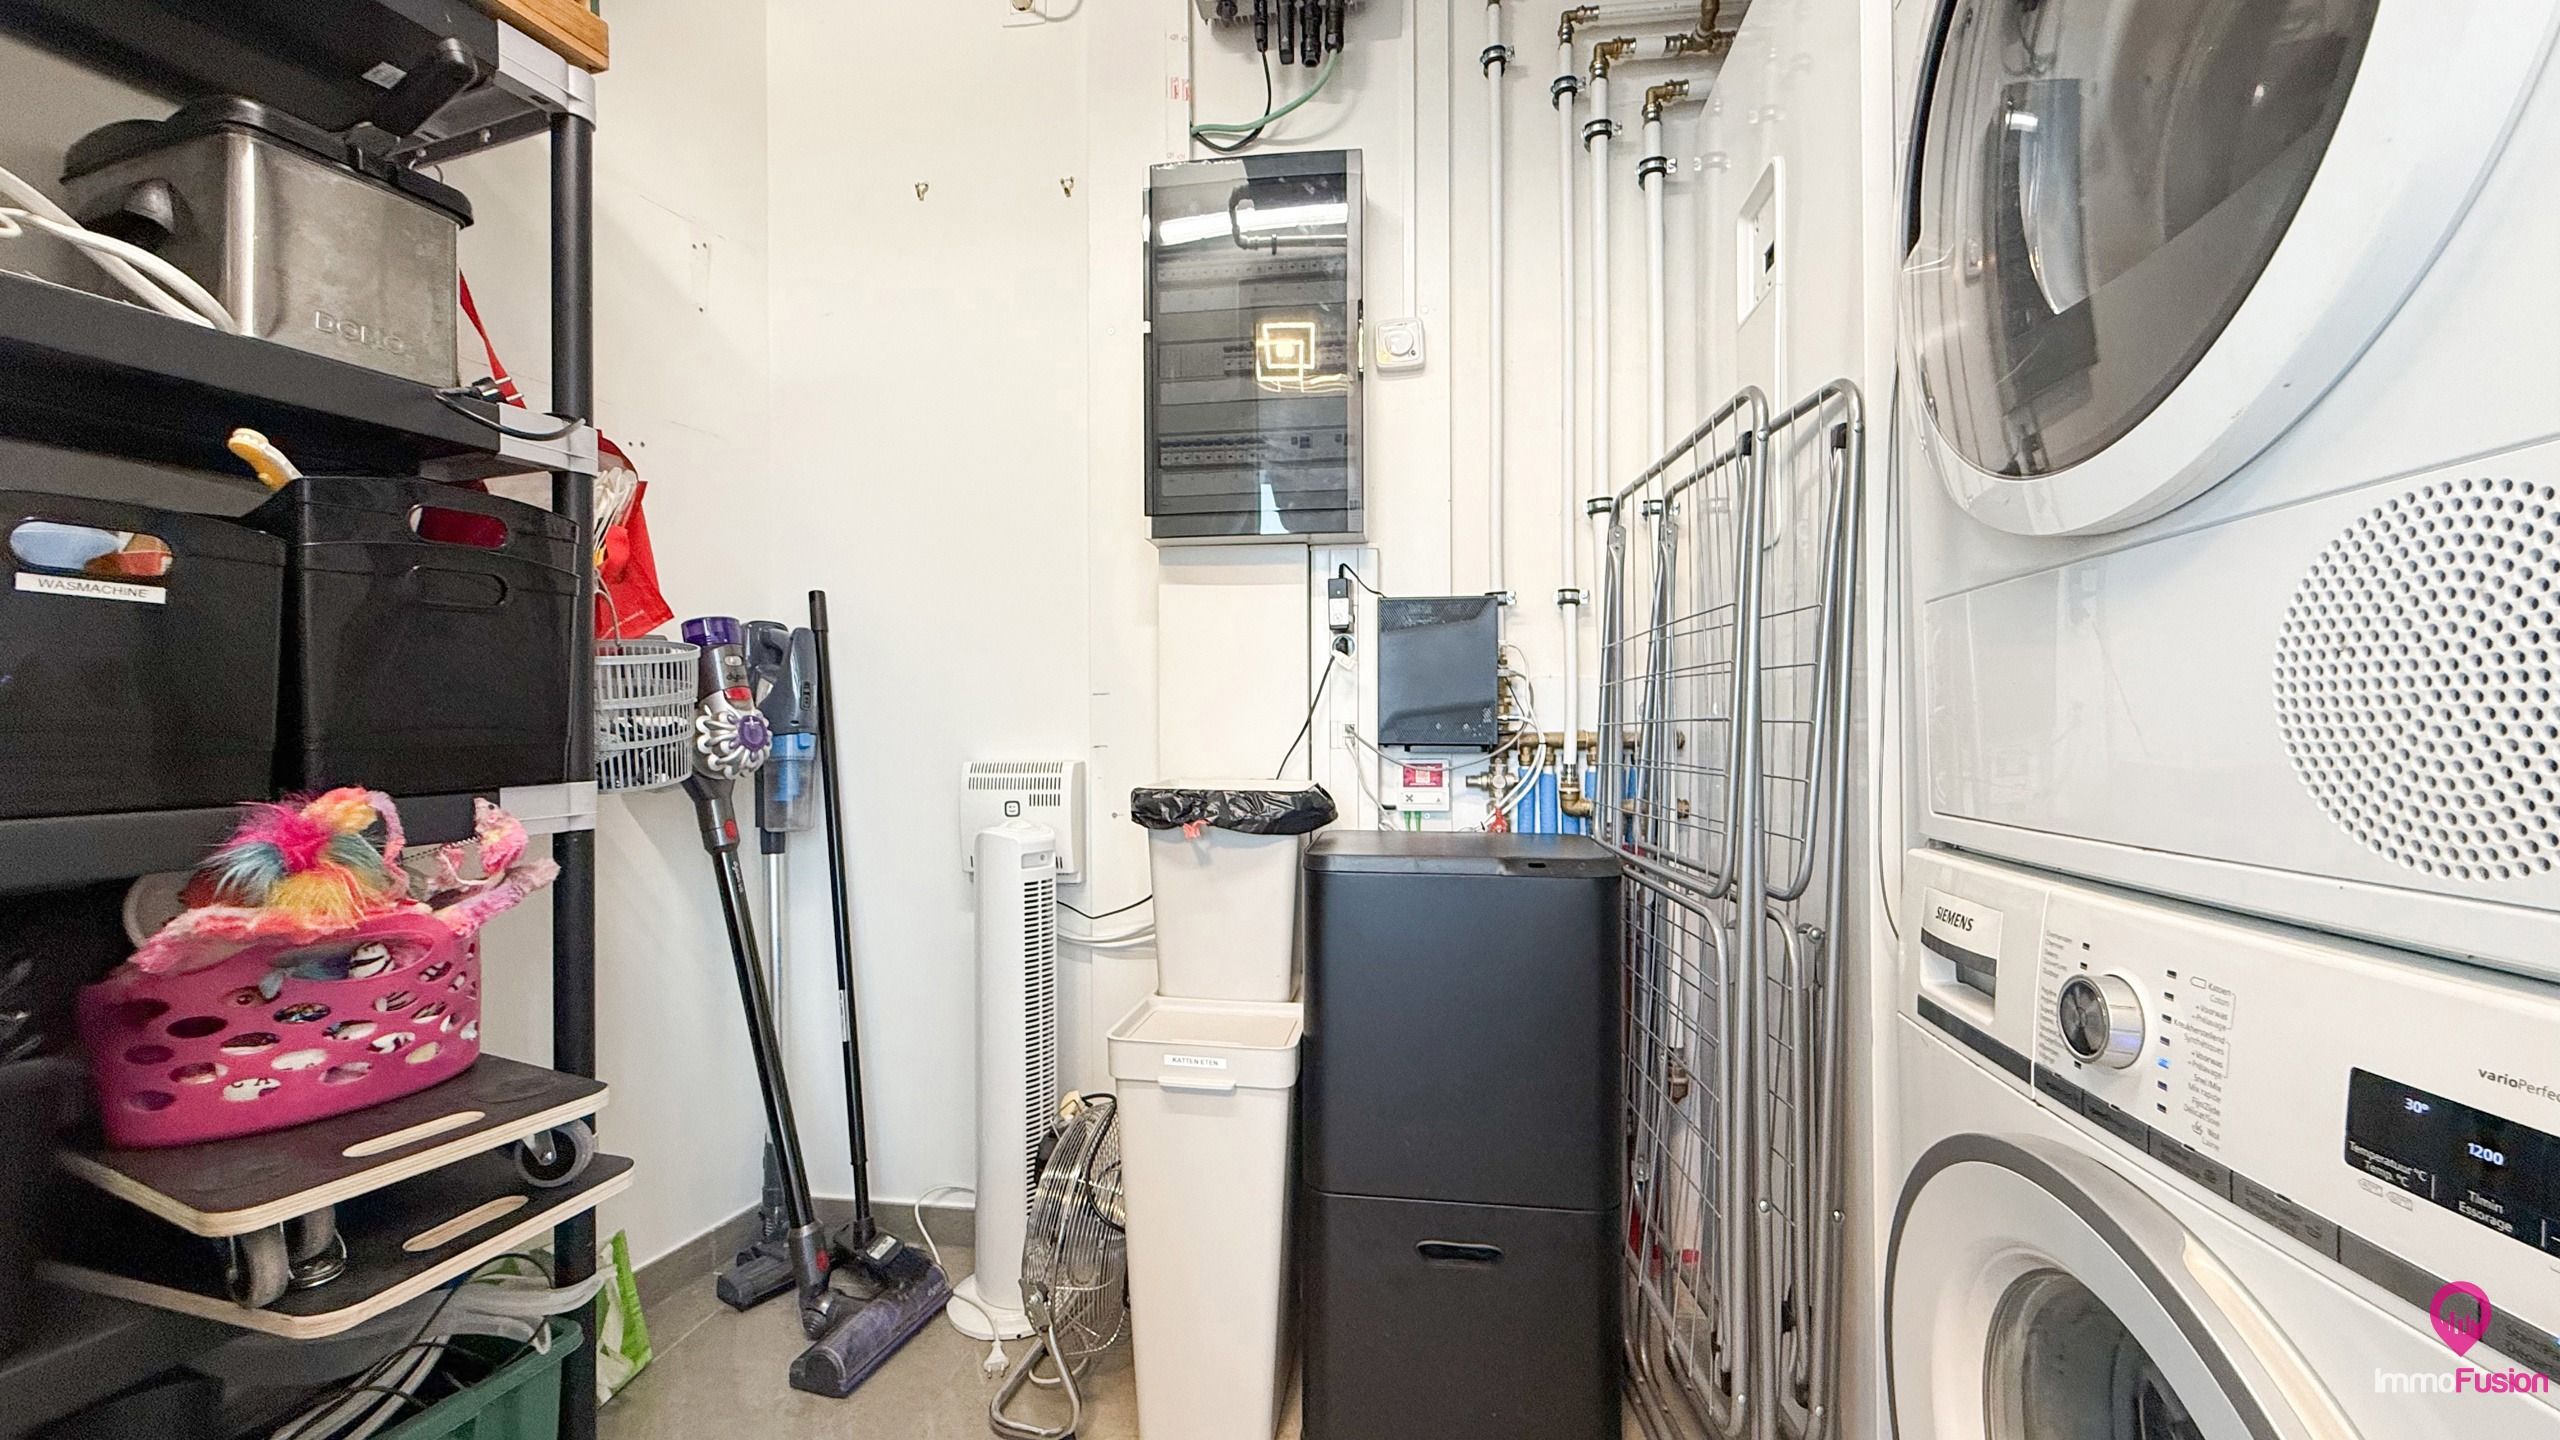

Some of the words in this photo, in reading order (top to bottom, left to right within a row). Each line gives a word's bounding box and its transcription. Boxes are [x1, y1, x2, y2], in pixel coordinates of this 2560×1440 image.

[37, 577, 150, 599] WASMACHINE
[1935, 906, 1975, 932] SIEMENS
[1172, 1057, 1199, 1065] KATTEN
[2466, 1142, 2505, 1167] 1200
[2458, 1200, 2514, 1233] Essorage
